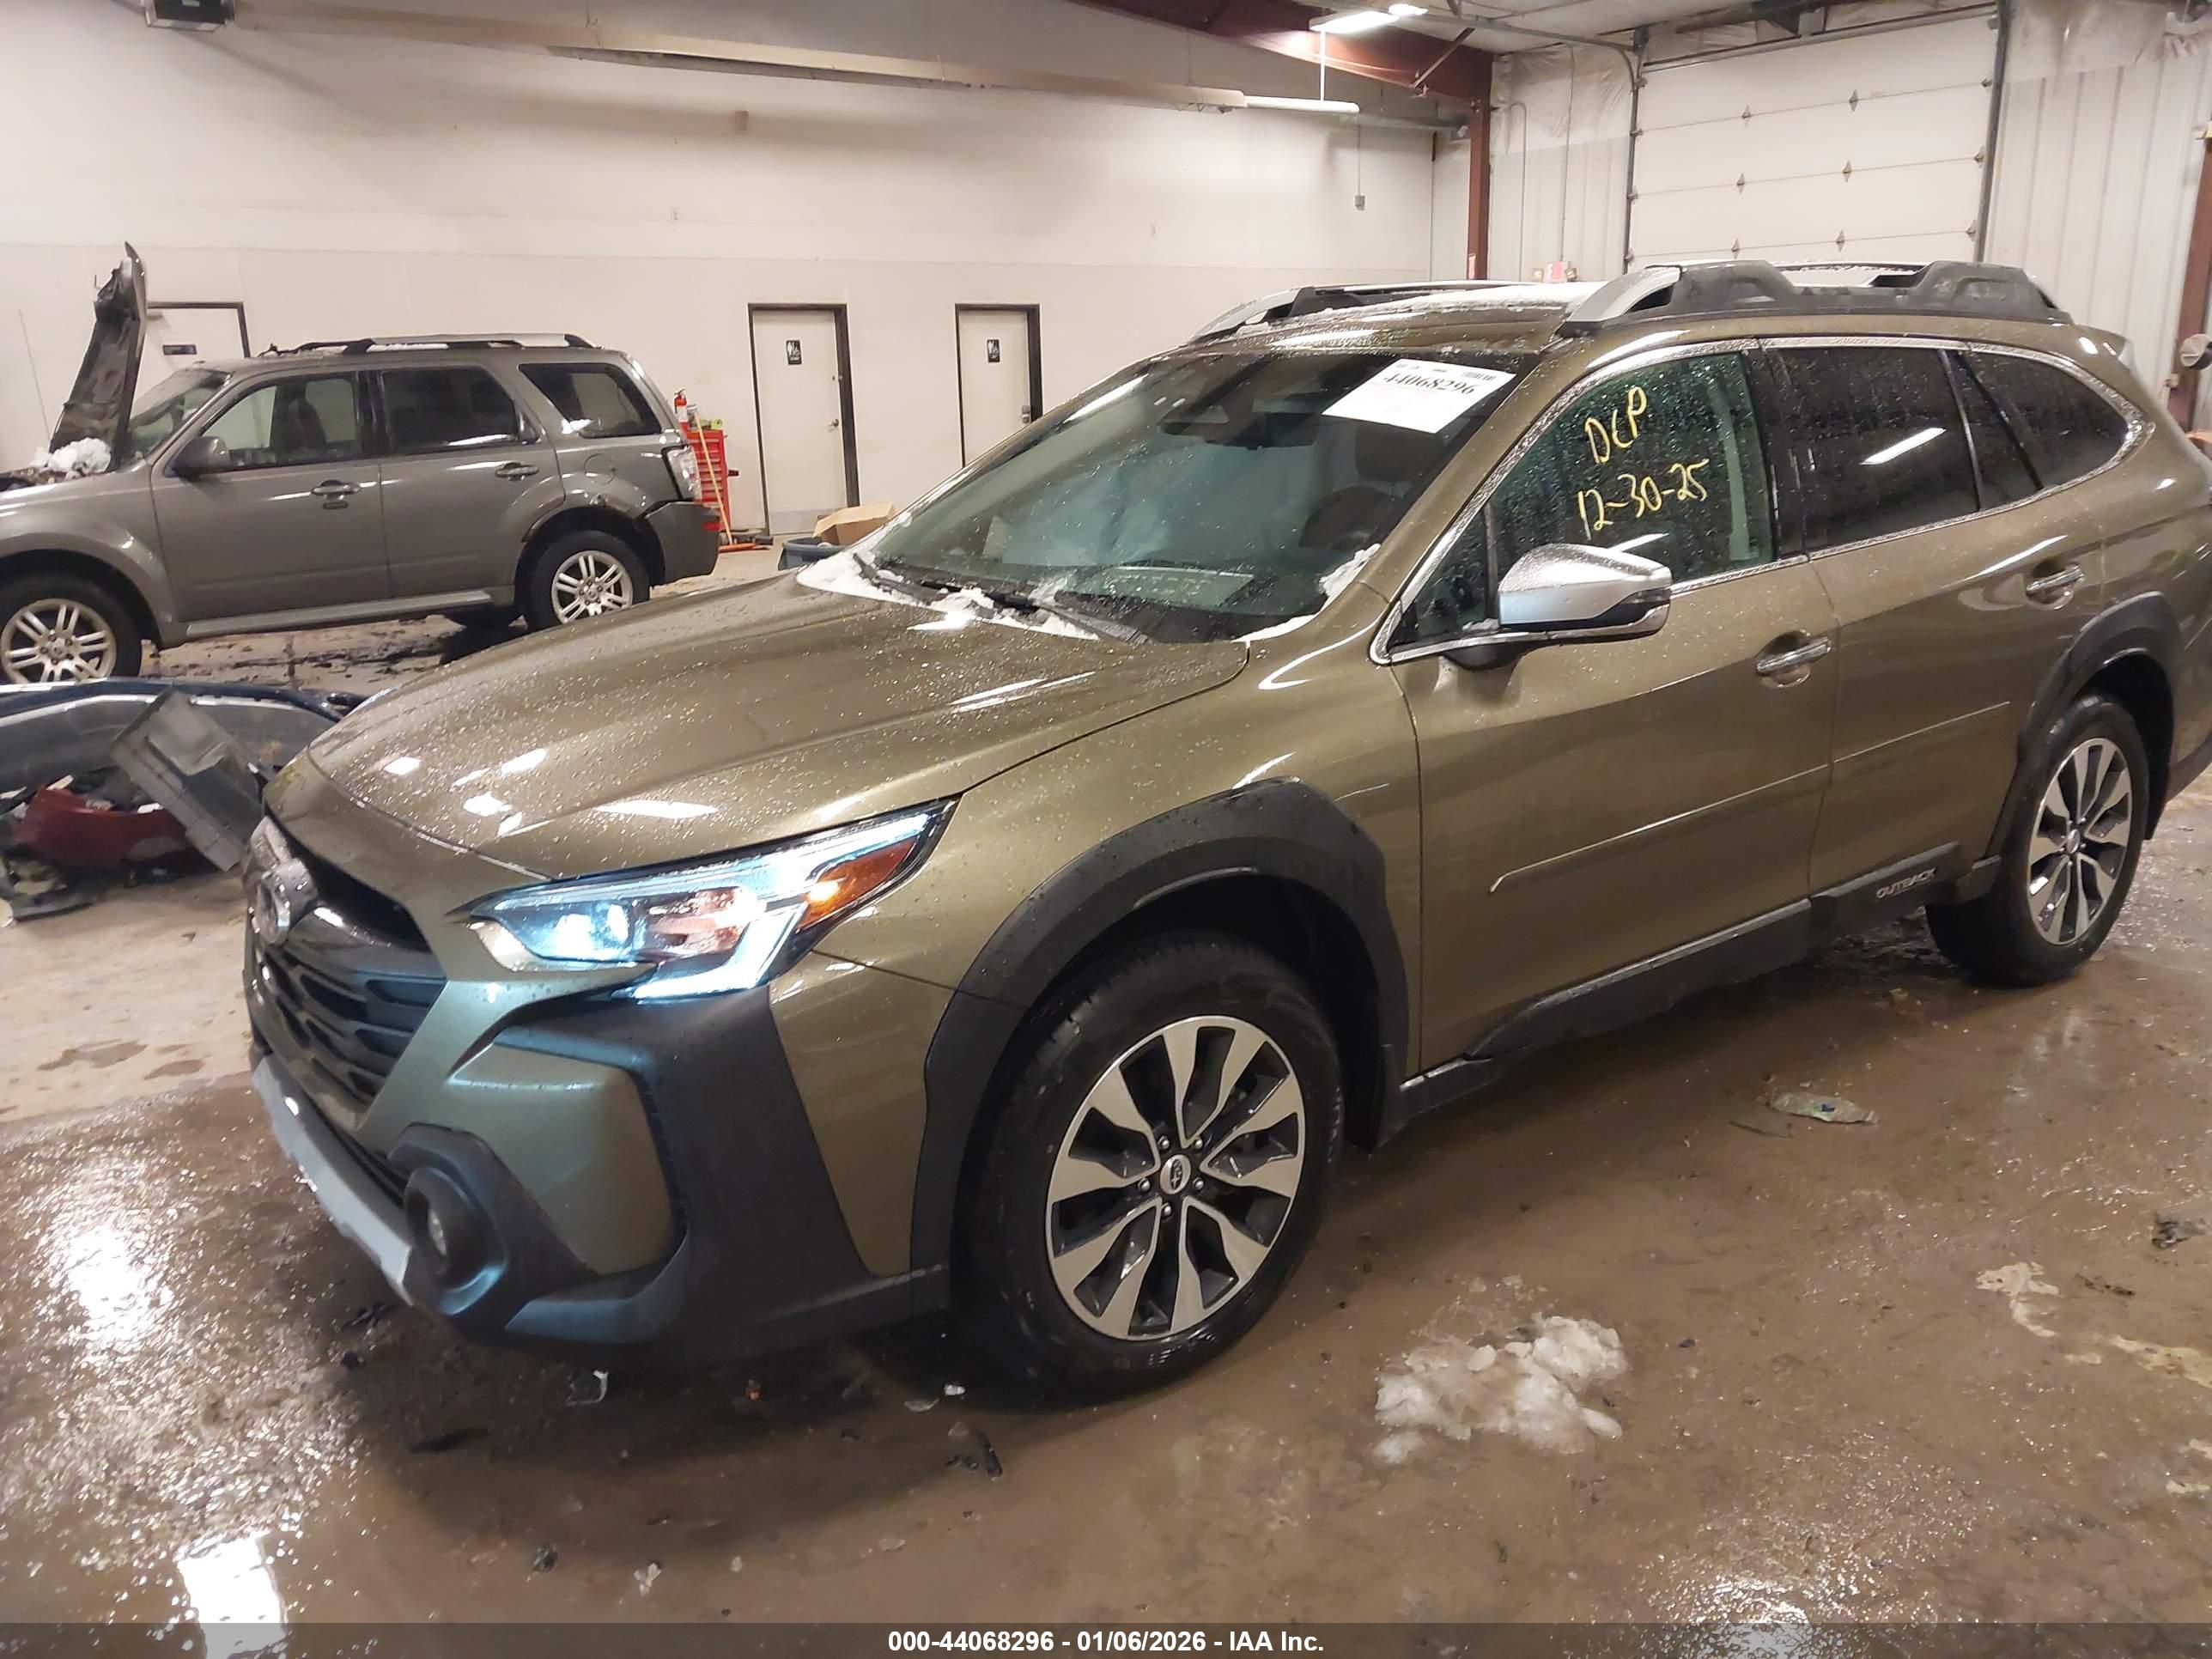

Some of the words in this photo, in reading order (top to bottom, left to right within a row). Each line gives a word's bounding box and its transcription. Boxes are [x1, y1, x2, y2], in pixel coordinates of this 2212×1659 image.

[1383, 373, 1479, 395] 44068296
[1584, 386, 1648, 465] DCP
[1577, 458, 1710, 540] 12-30-25
[1875, 866, 1936, 898] OUTBACK
